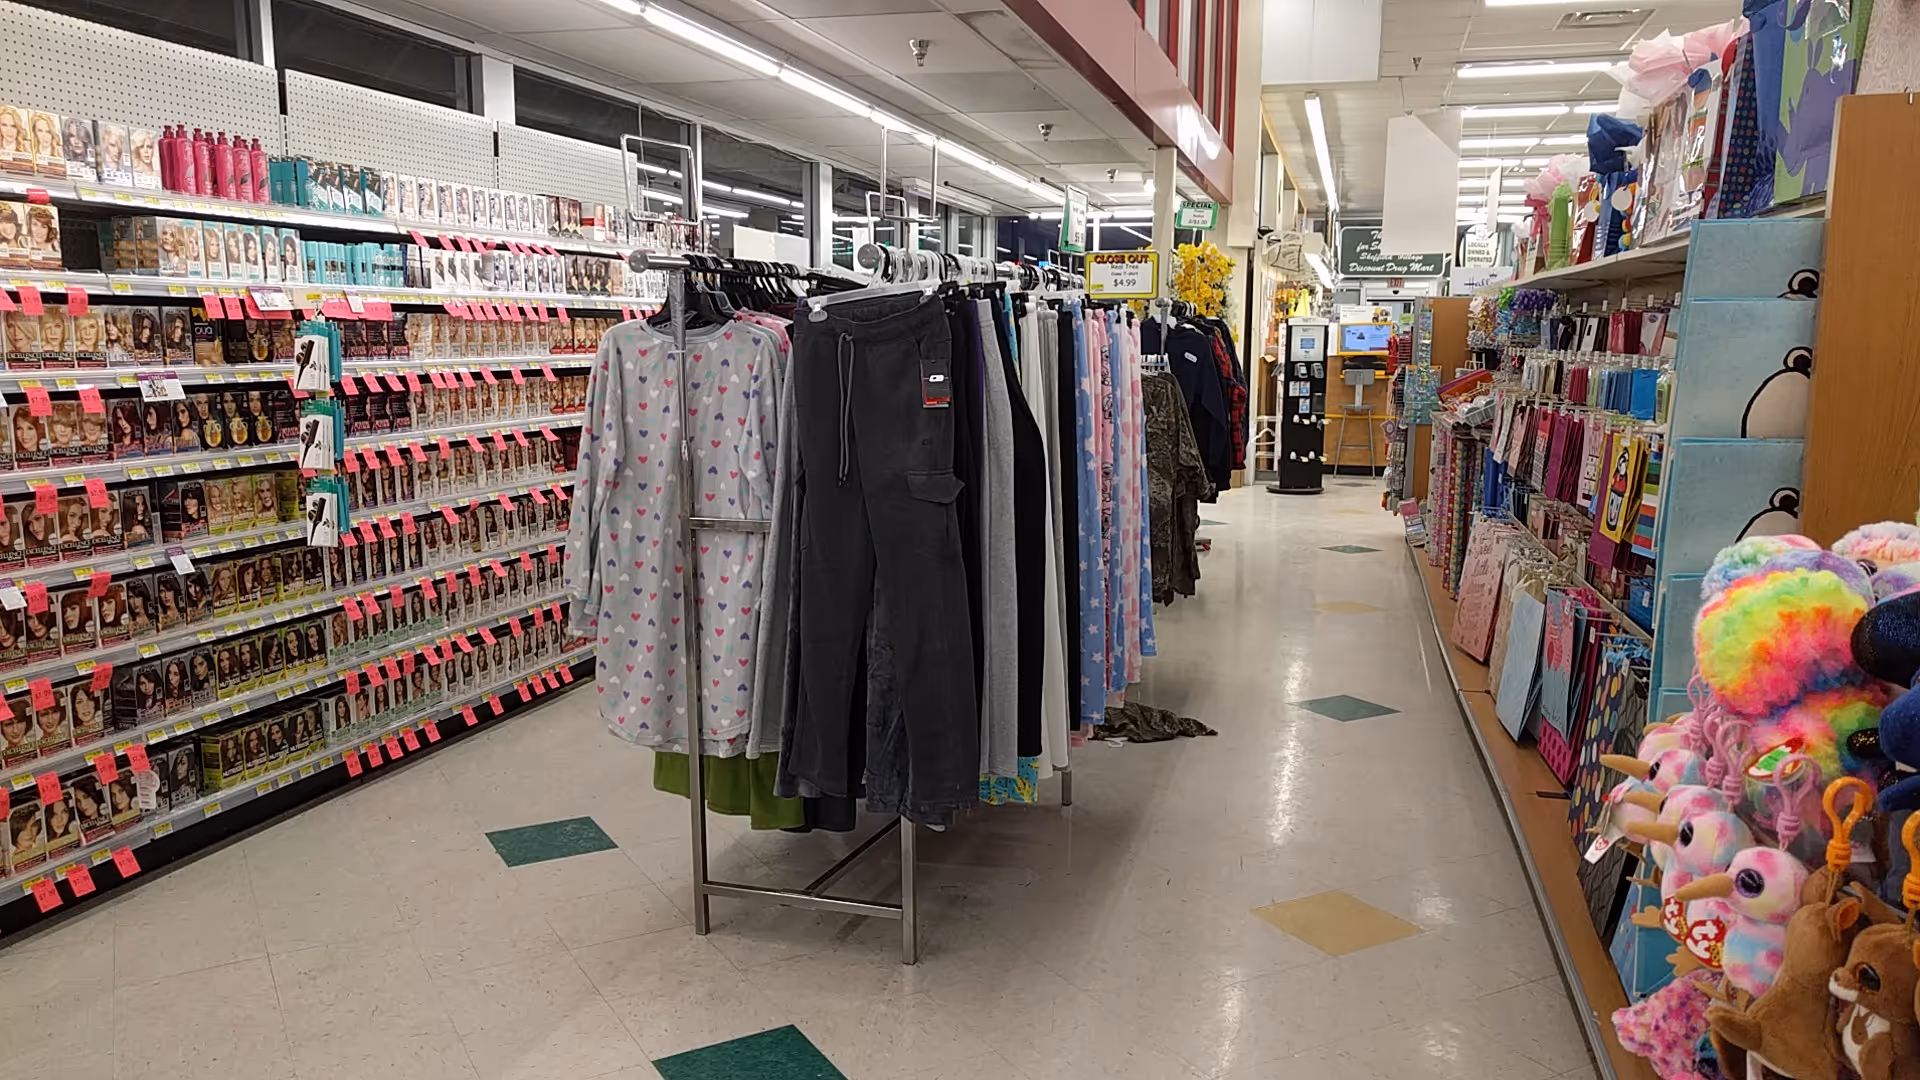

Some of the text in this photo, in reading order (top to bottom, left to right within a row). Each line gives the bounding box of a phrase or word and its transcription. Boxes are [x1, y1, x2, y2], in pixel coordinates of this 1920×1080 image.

[1182, 201, 1212, 209] SPECIAL
[1356, 242, 1369, 253] for
[1094, 254, 1150, 264] CLOSE OUT
[1349, 262, 1435, 274] Discount Drug Mart
[1113, 278, 1137, 287] $4.99
[1664, 899, 1680, 935] ty
[1686, 920, 1719, 959] ty
